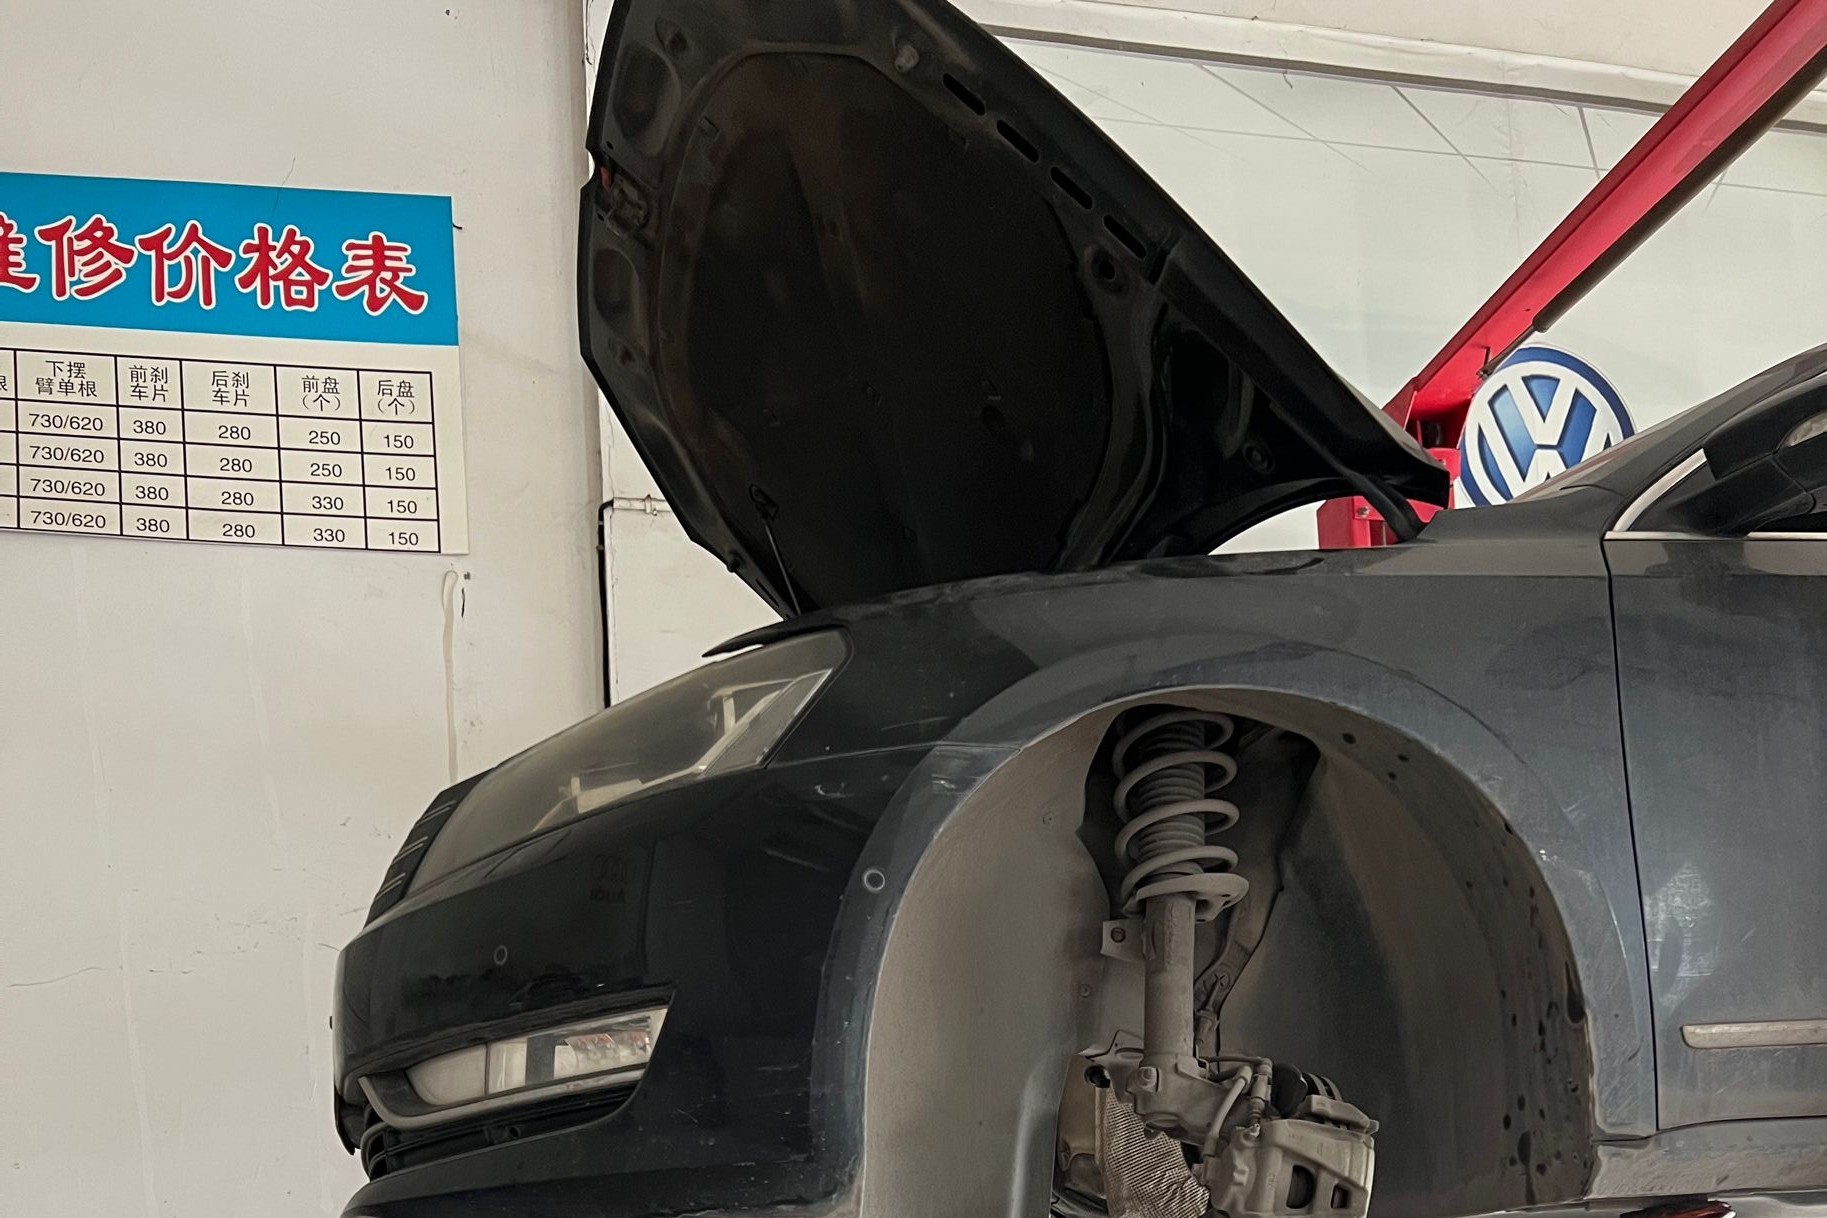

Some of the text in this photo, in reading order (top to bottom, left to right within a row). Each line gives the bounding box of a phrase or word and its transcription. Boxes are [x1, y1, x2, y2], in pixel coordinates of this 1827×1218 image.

[45, 359, 86, 379] 下摆
[129, 365, 168, 384] 前刹
[35, 377, 97, 397] 臂单根
[212, 370, 249, 389] 后刹
[302, 375, 340, 395] 前盘
[130, 384, 168, 402] 车片
[378, 380, 414, 398] 后盘
[212, 389, 249, 407] 车片
[29, 413, 103, 431] 730/620
[133, 420, 166, 435] 380
[219, 425, 251, 440] 280
[309, 431, 340, 445] 250
[384, 434, 414, 449] 150
[29, 446, 104, 464] 730/620
[134, 452, 167, 467] 380
[220, 458, 252, 472] 280
[310, 463, 342, 477] 250
[386, 467, 415, 481] 150
[29, 479, 105, 497] 730/620
[136, 486, 168, 500] 380
[222, 491, 254, 506] 280
[312, 496, 343, 510] 330
[387, 500, 417, 514] 150
[30, 511, 106, 529] 730/620
[137, 518, 170, 533] 380
[223, 524, 255, 538] 280
[314, 528, 345, 542] 330
[389, 532, 418, 545] 150
